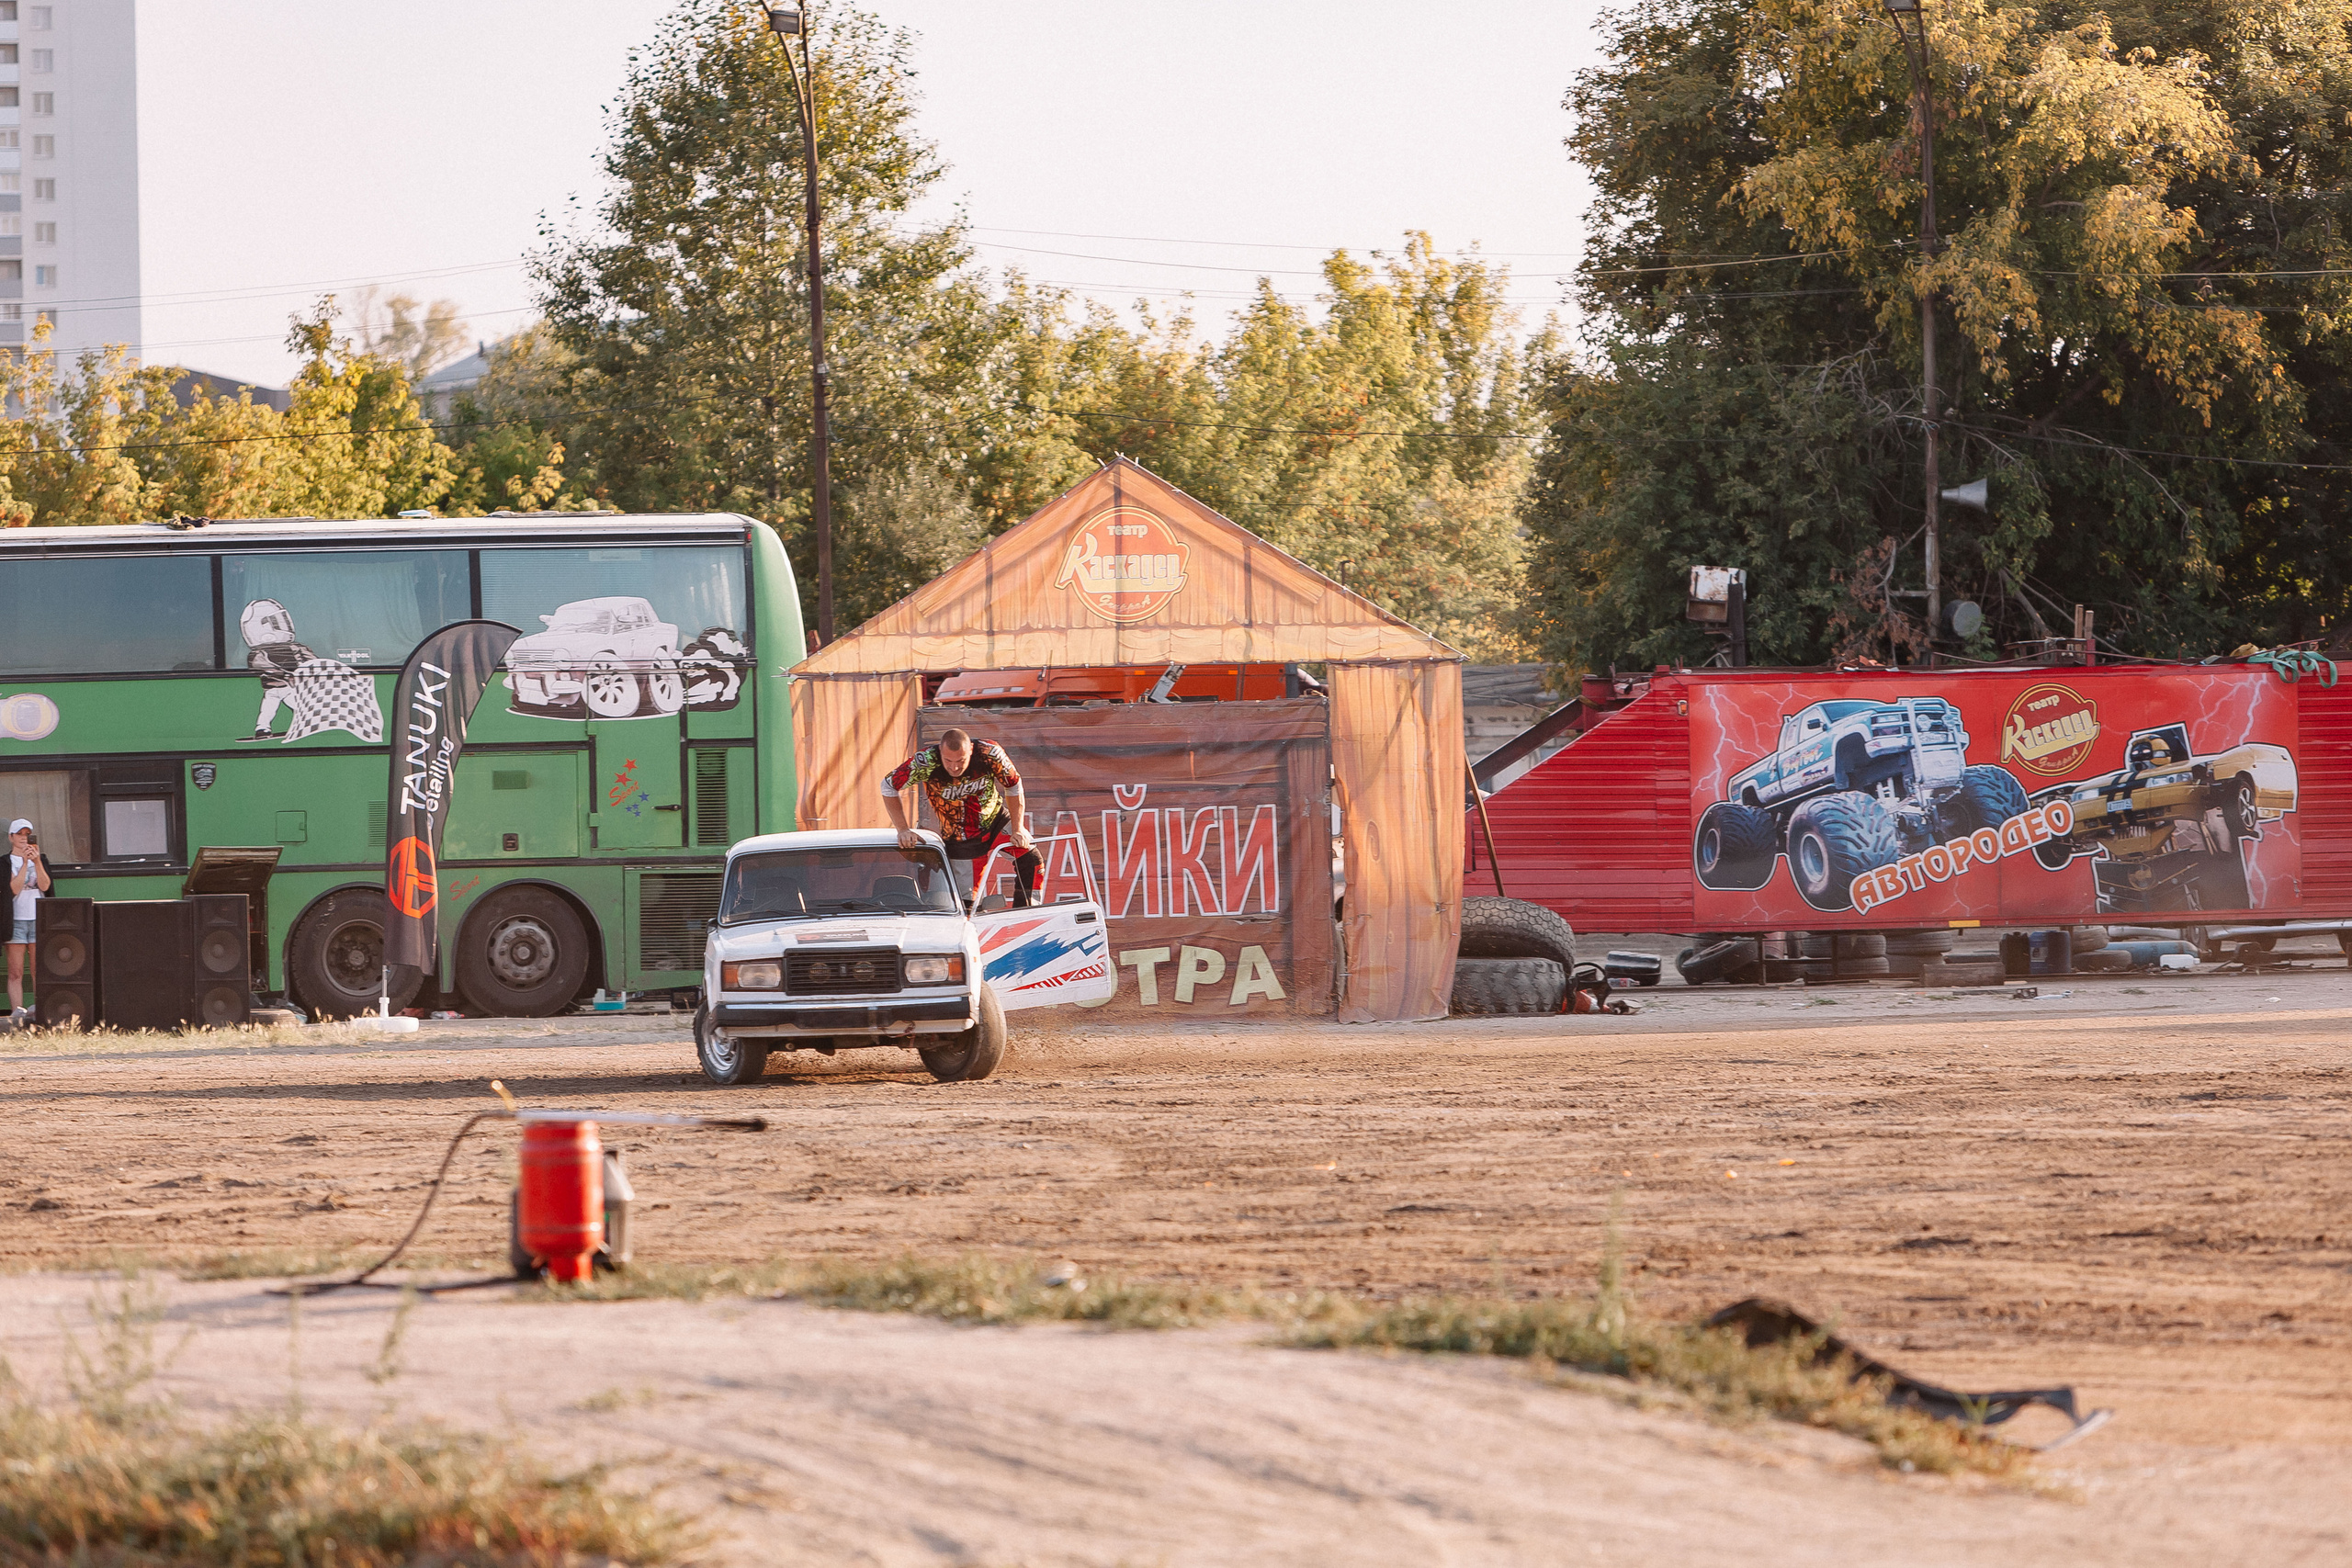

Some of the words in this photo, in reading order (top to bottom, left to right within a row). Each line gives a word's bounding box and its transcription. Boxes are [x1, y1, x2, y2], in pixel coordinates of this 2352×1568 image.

[1107, 525, 1148, 538] театр
[1060, 533, 1183, 593] Каскадер
[2027, 694, 2060, 712] театр
[400, 661, 451, 815] TANUKI
[2004, 709, 2098, 761] Каскадер
[1850, 801, 2074, 914] АВТОРОДЕО
[1070, 944, 1287, 1008] ТРА
